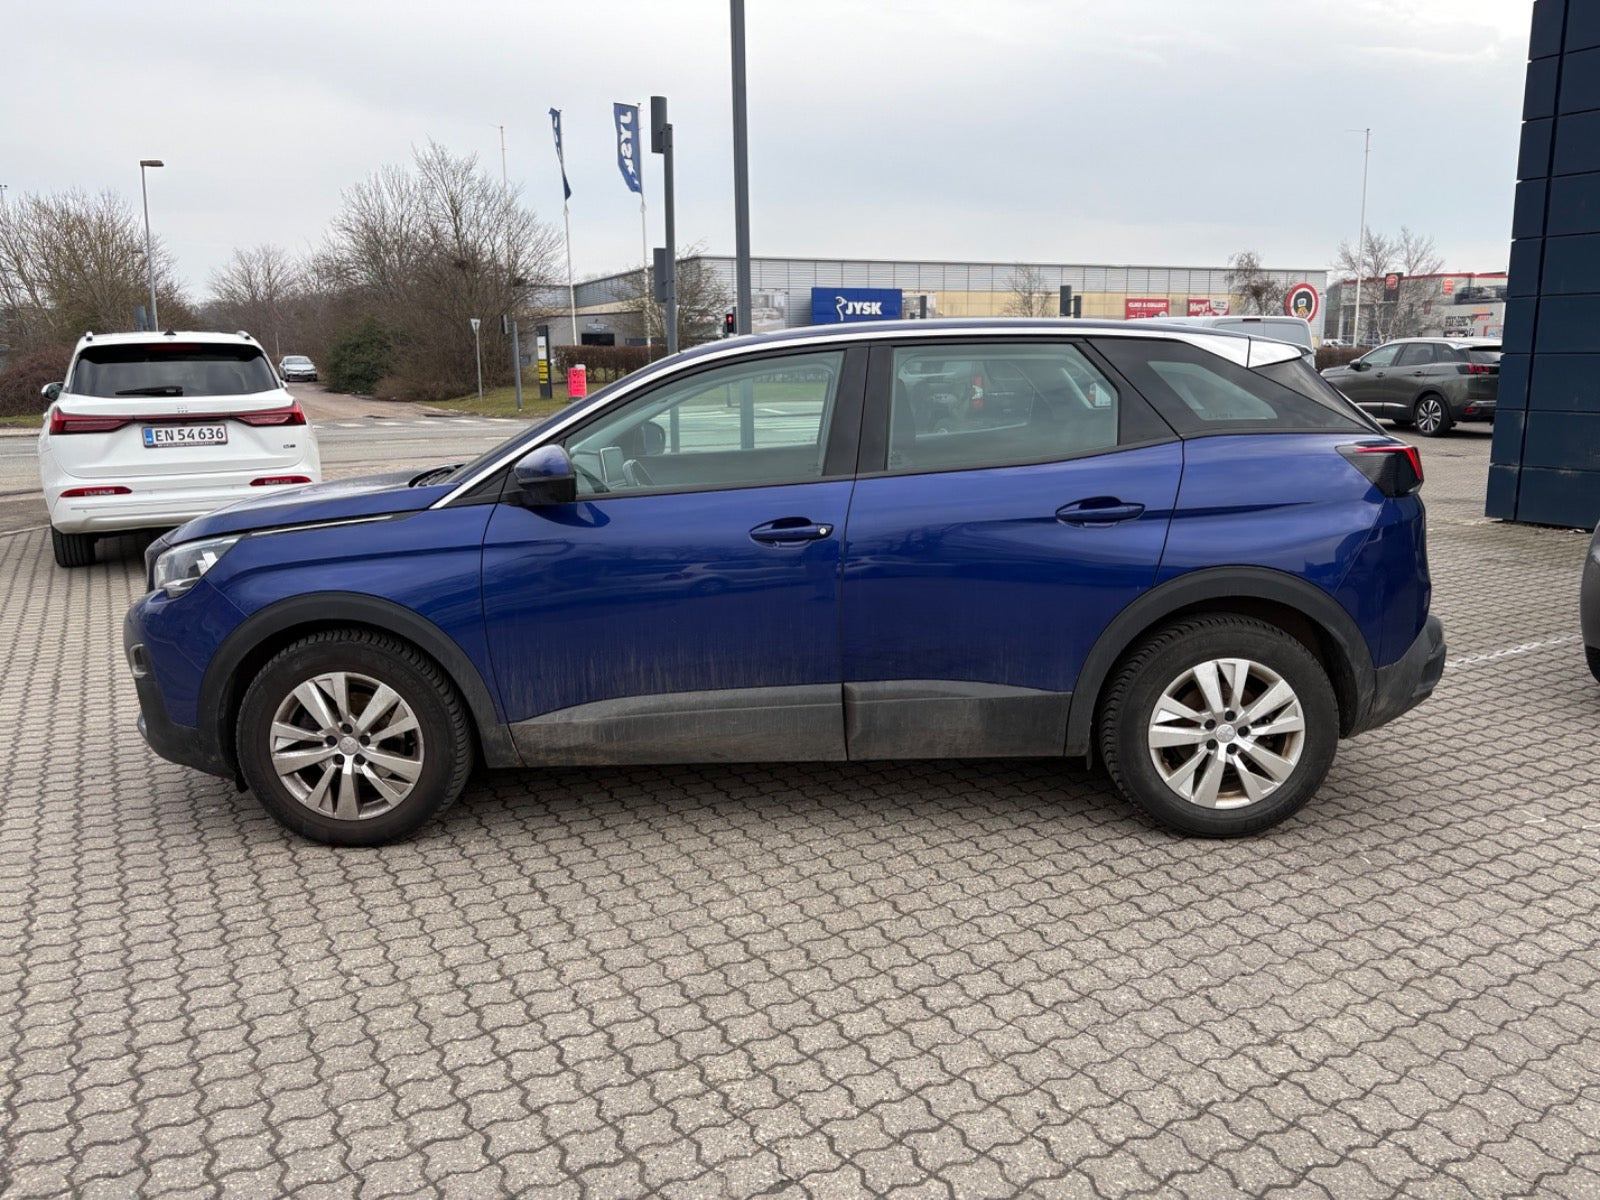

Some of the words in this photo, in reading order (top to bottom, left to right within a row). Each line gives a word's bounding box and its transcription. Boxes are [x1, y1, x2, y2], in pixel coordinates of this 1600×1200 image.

[845, 301, 882, 315] JYSK
[1189, 302, 1209, 312] Hey!
[155, 429, 174, 442] EN
[177, 429, 195, 441] 54
[198, 427, 224, 440] 636
